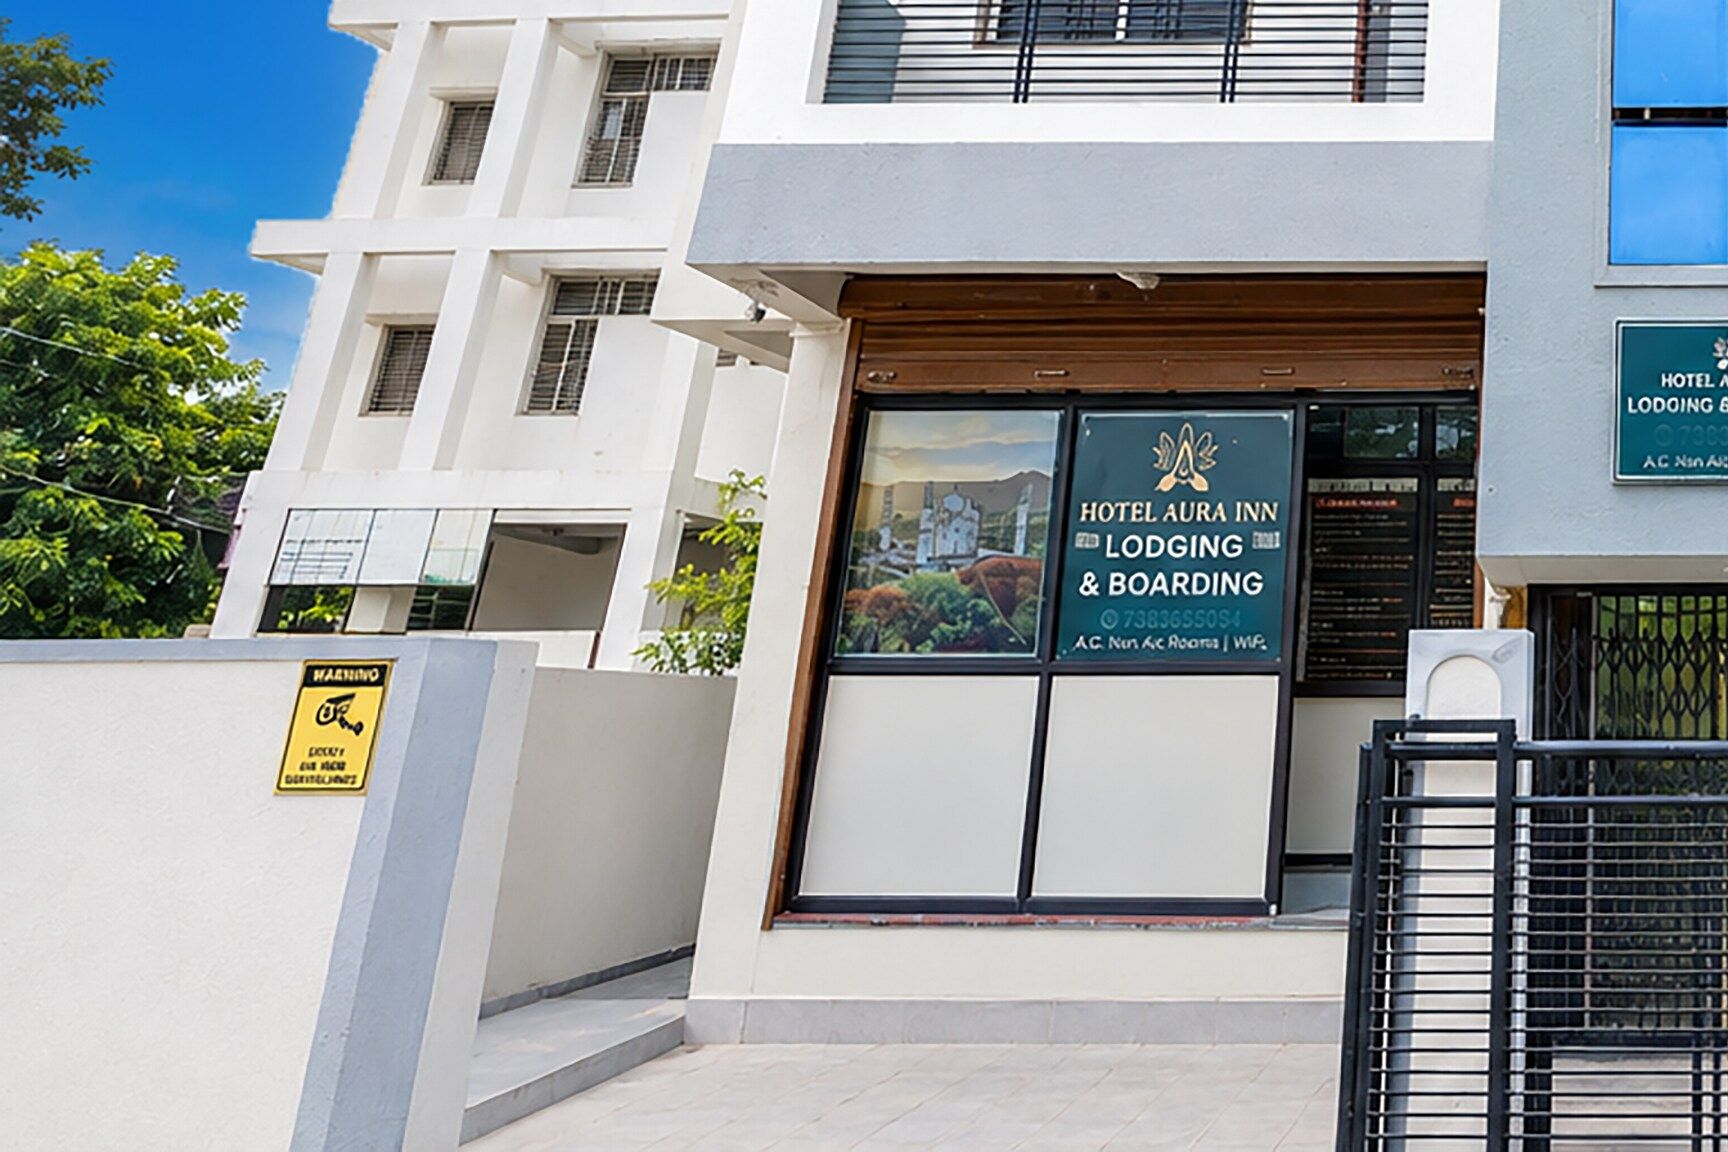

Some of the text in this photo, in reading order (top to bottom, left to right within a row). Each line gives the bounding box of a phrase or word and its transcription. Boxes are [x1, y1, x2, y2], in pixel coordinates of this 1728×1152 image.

[1661, 373, 1715, 388] HOTEL
[1080, 502, 1279, 523] HOTEL AURA INN
[1106, 534, 1243, 558] LODGING
[1079, 572, 1264, 596] & BOARDING
